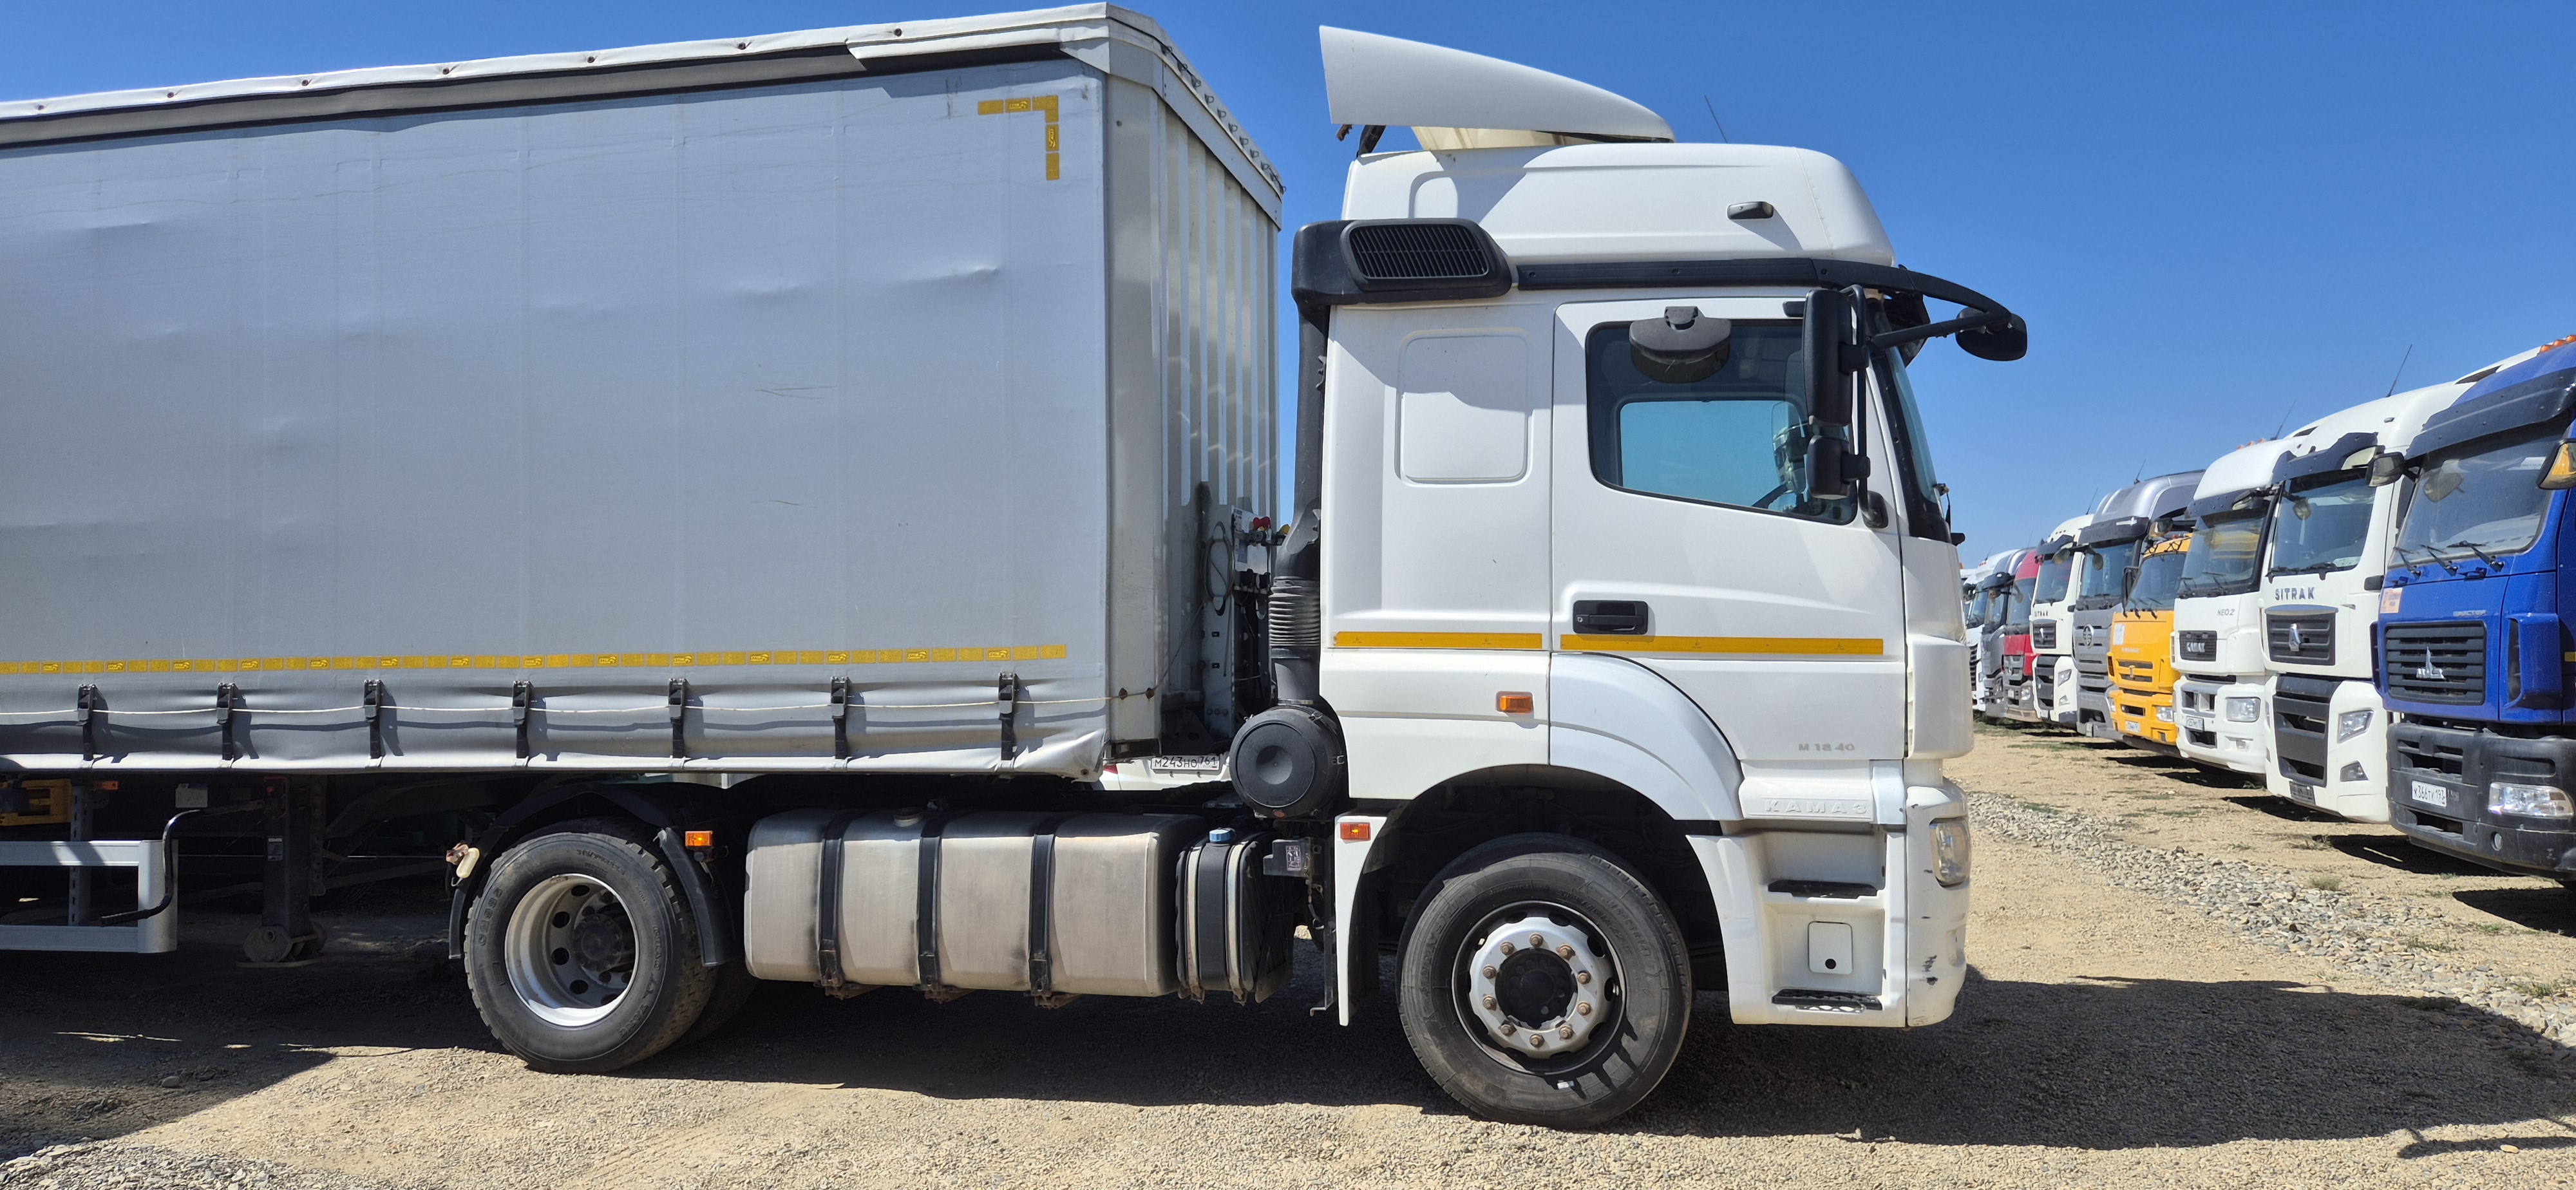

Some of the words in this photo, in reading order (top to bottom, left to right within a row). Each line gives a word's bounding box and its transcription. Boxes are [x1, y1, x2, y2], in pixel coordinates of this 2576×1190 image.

[2275, 586, 2315, 601] SITRAK
[1798, 743, 1809, 751] M
[1199, 756, 1217, 766] 761
[2435, 788, 2445, 800] 193
[1764, 799, 1867, 815] КАМАЗ
